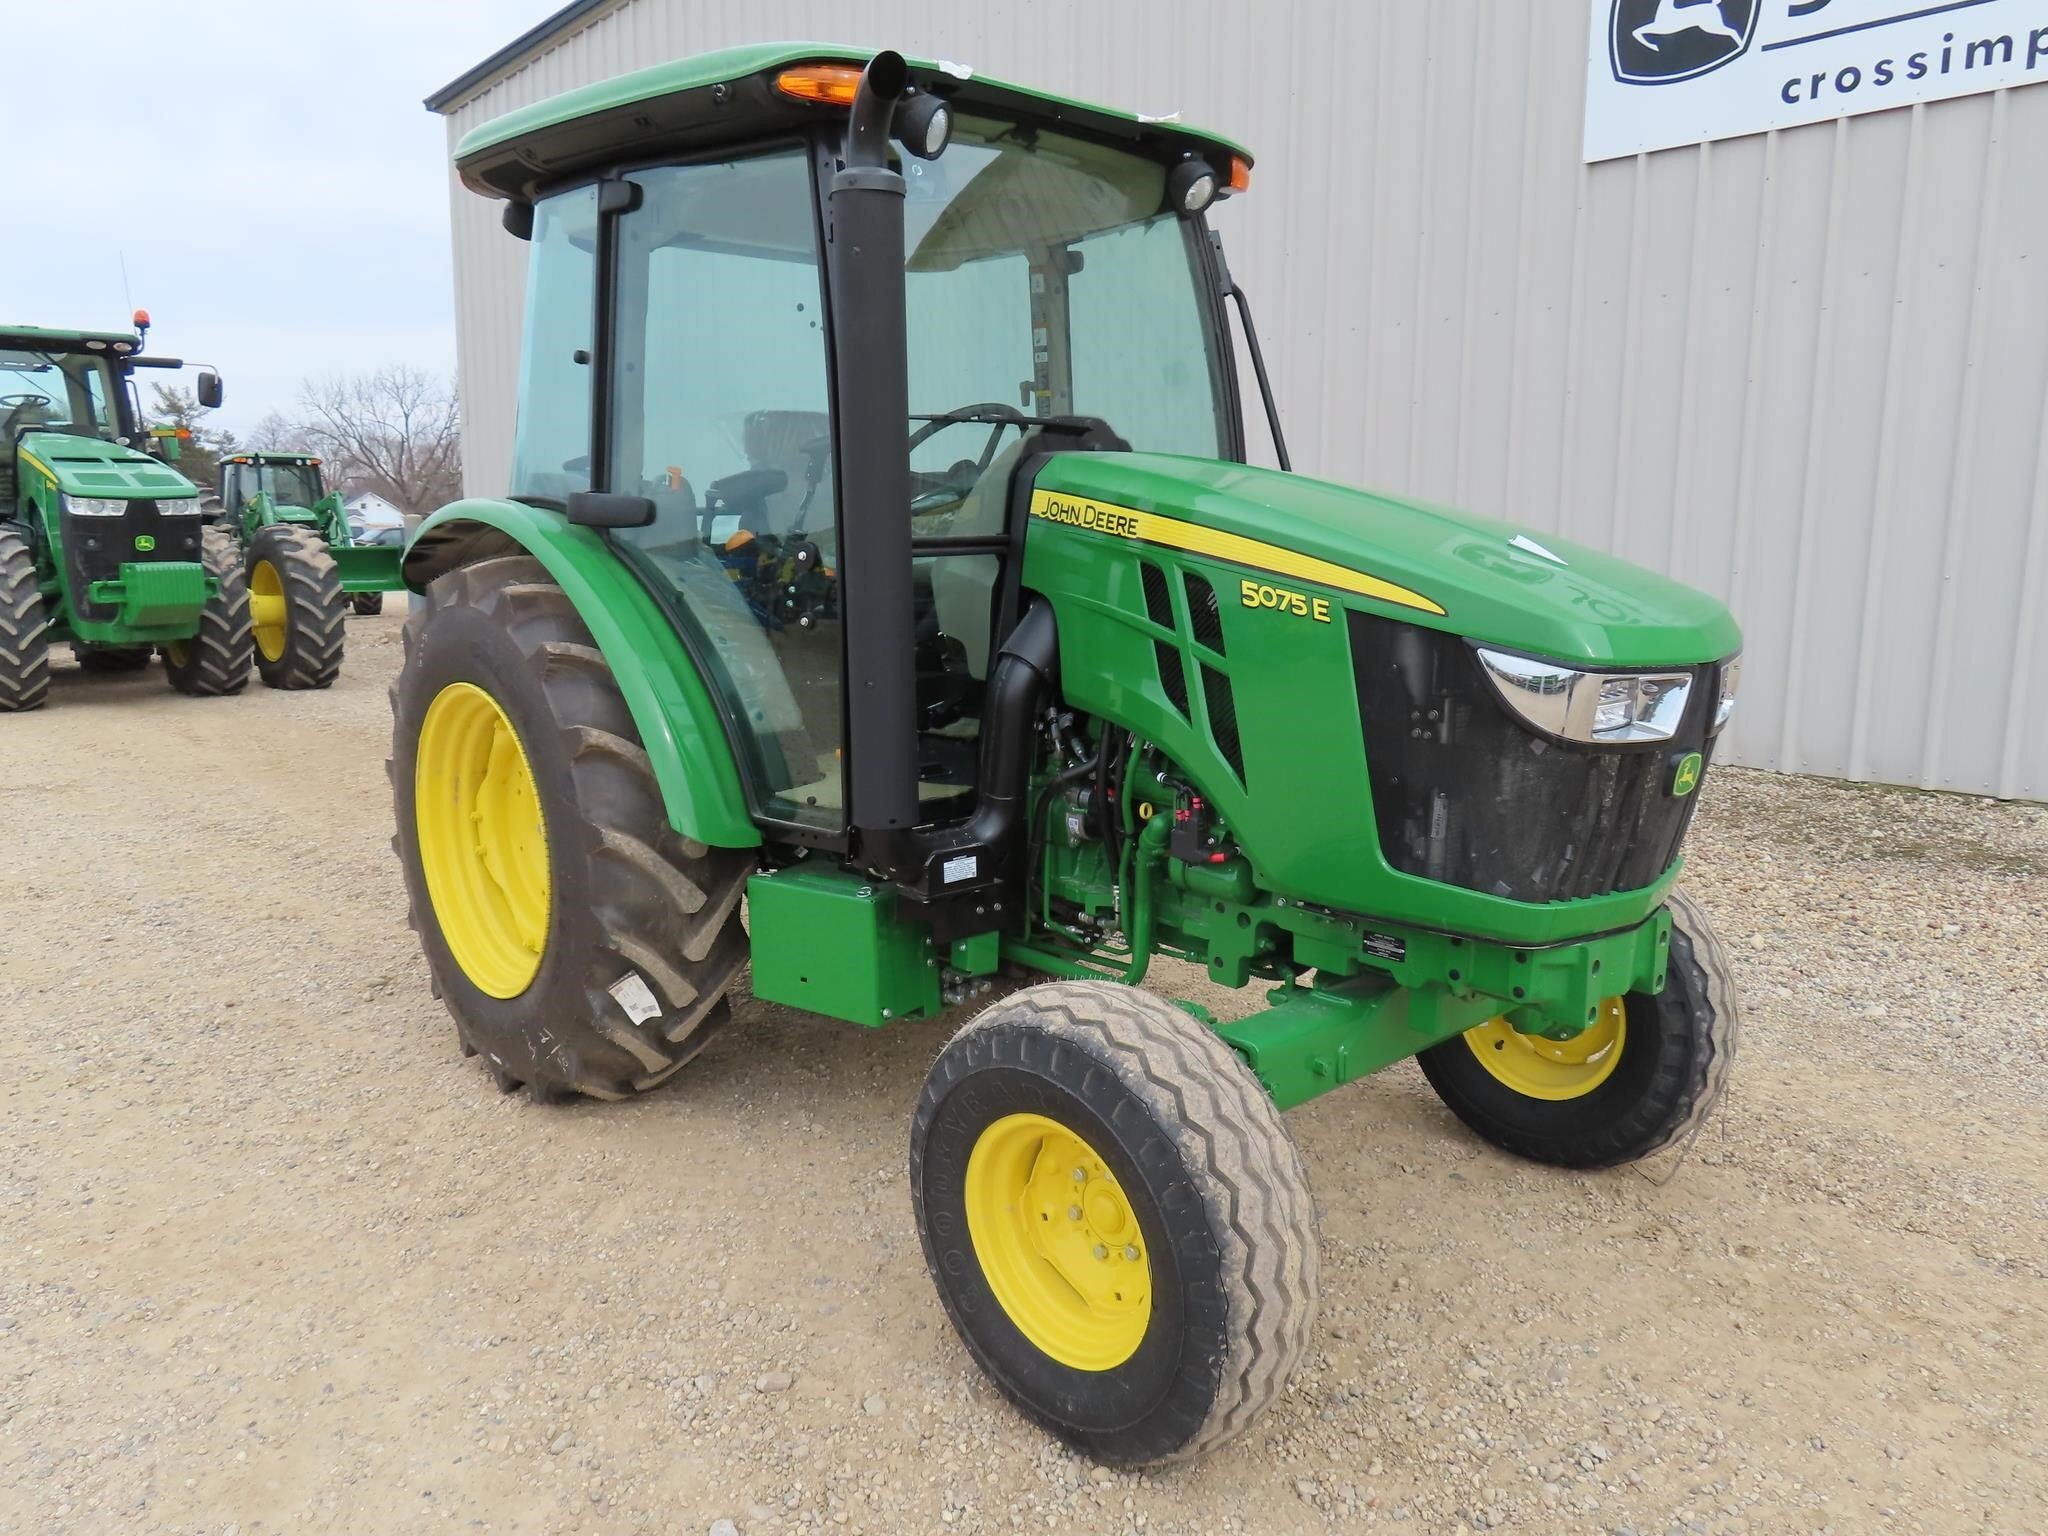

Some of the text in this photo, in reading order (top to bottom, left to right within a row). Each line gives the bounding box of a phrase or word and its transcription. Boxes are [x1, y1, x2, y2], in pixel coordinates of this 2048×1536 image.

[1040, 496, 1139, 536] JOHN DEERE
[1241, 579, 1332, 623] 5075 E
